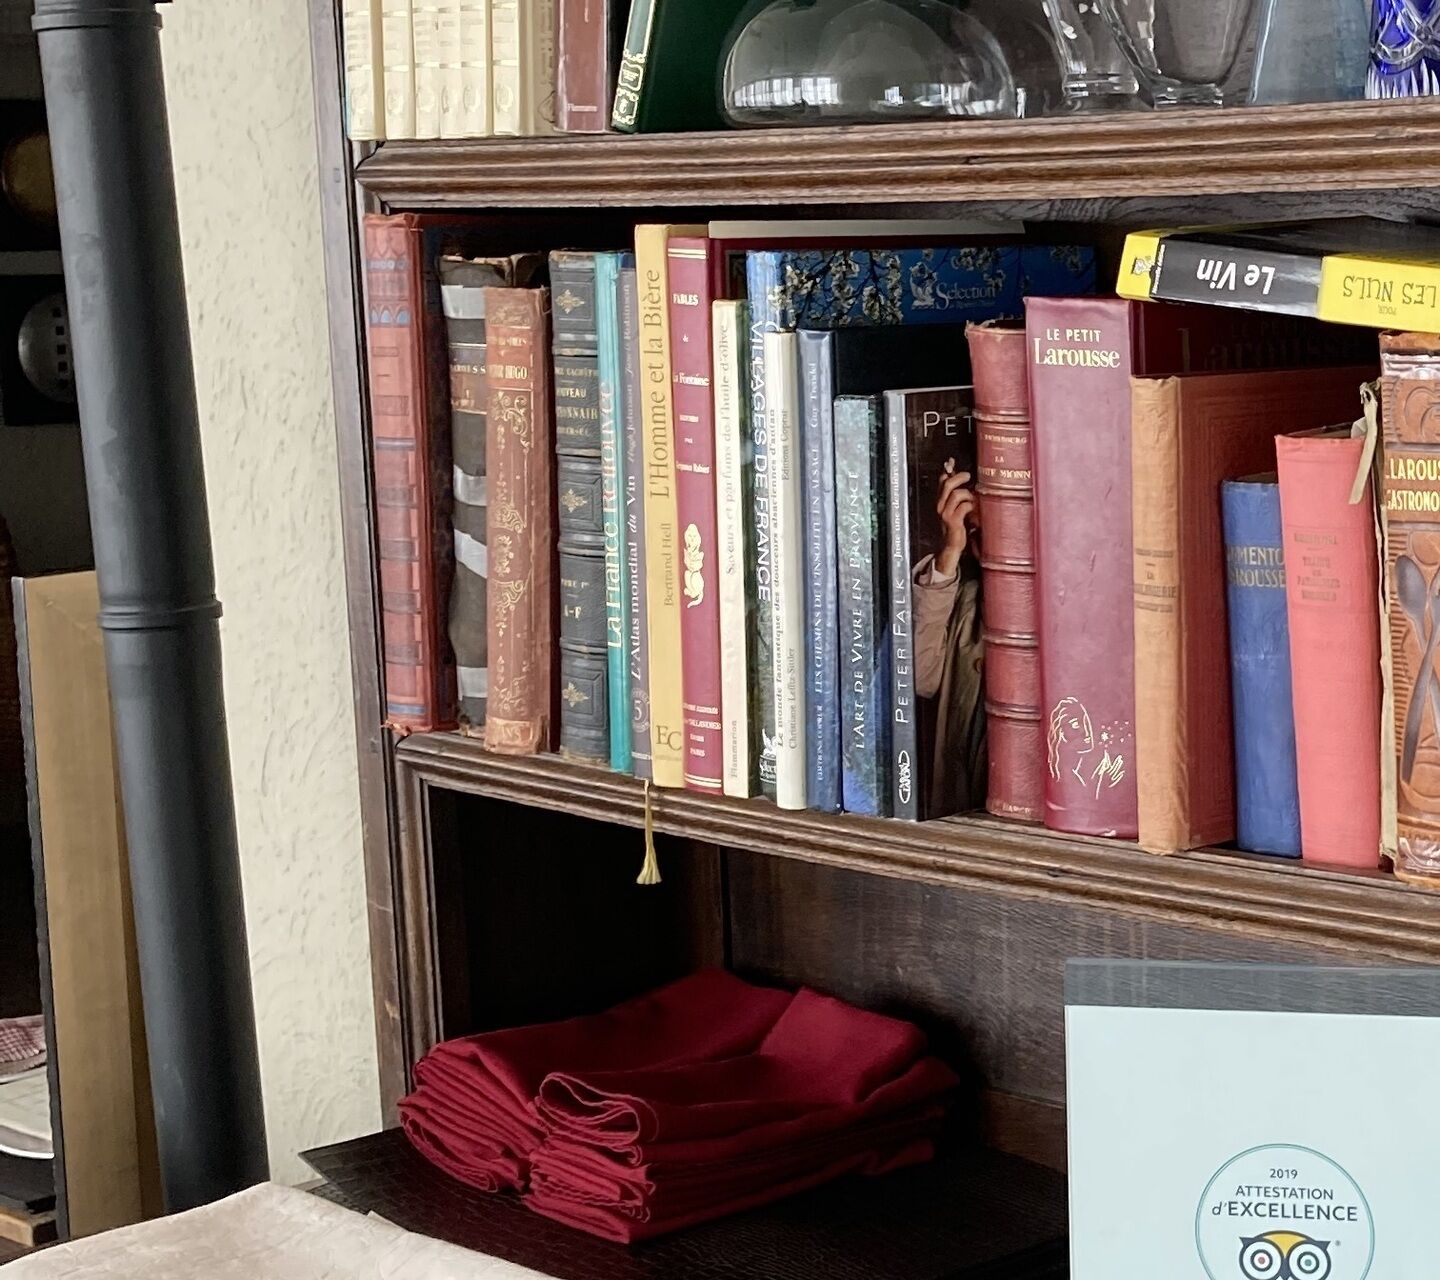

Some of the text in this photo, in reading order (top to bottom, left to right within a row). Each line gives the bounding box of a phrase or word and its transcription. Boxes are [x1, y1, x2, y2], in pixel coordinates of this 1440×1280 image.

[1196, 257, 1276, 295] Vin Le
[1343, 275, 1438, 309] LES NULS
[1034, 337, 1121, 369] Larousse
[1046, 328, 1101, 342] LE PETIT
[641, 269, 669, 499] L'Homme et la Bière
[750, 321, 771, 602] VILLAGES DE FRANCE
[625, 475, 637, 507] Vin
[629, 514, 638, 533] du
[604, 522, 622, 612] France
[628, 541, 642, 614] mondial
[662, 522, 673, 607] Bertrand Hell
[849, 470, 865, 749] L'ART DE VIVRE EN PROVENCE
[607, 616, 623, 650] La
[629, 617, 644, 681] L'Atlas
[814, 612, 823, 668] CHEMINS
[893, 579, 908, 723] PETER FALK
[656, 725, 682, 751] EC
[729, 720, 738, 779] Flammarion
[1235, 1185, 1334, 1201] ATTESTATION
[1270, 1168, 1298, 1180] 2019
[1211, 1201, 1358, 1222] d'EXCELLENCE
